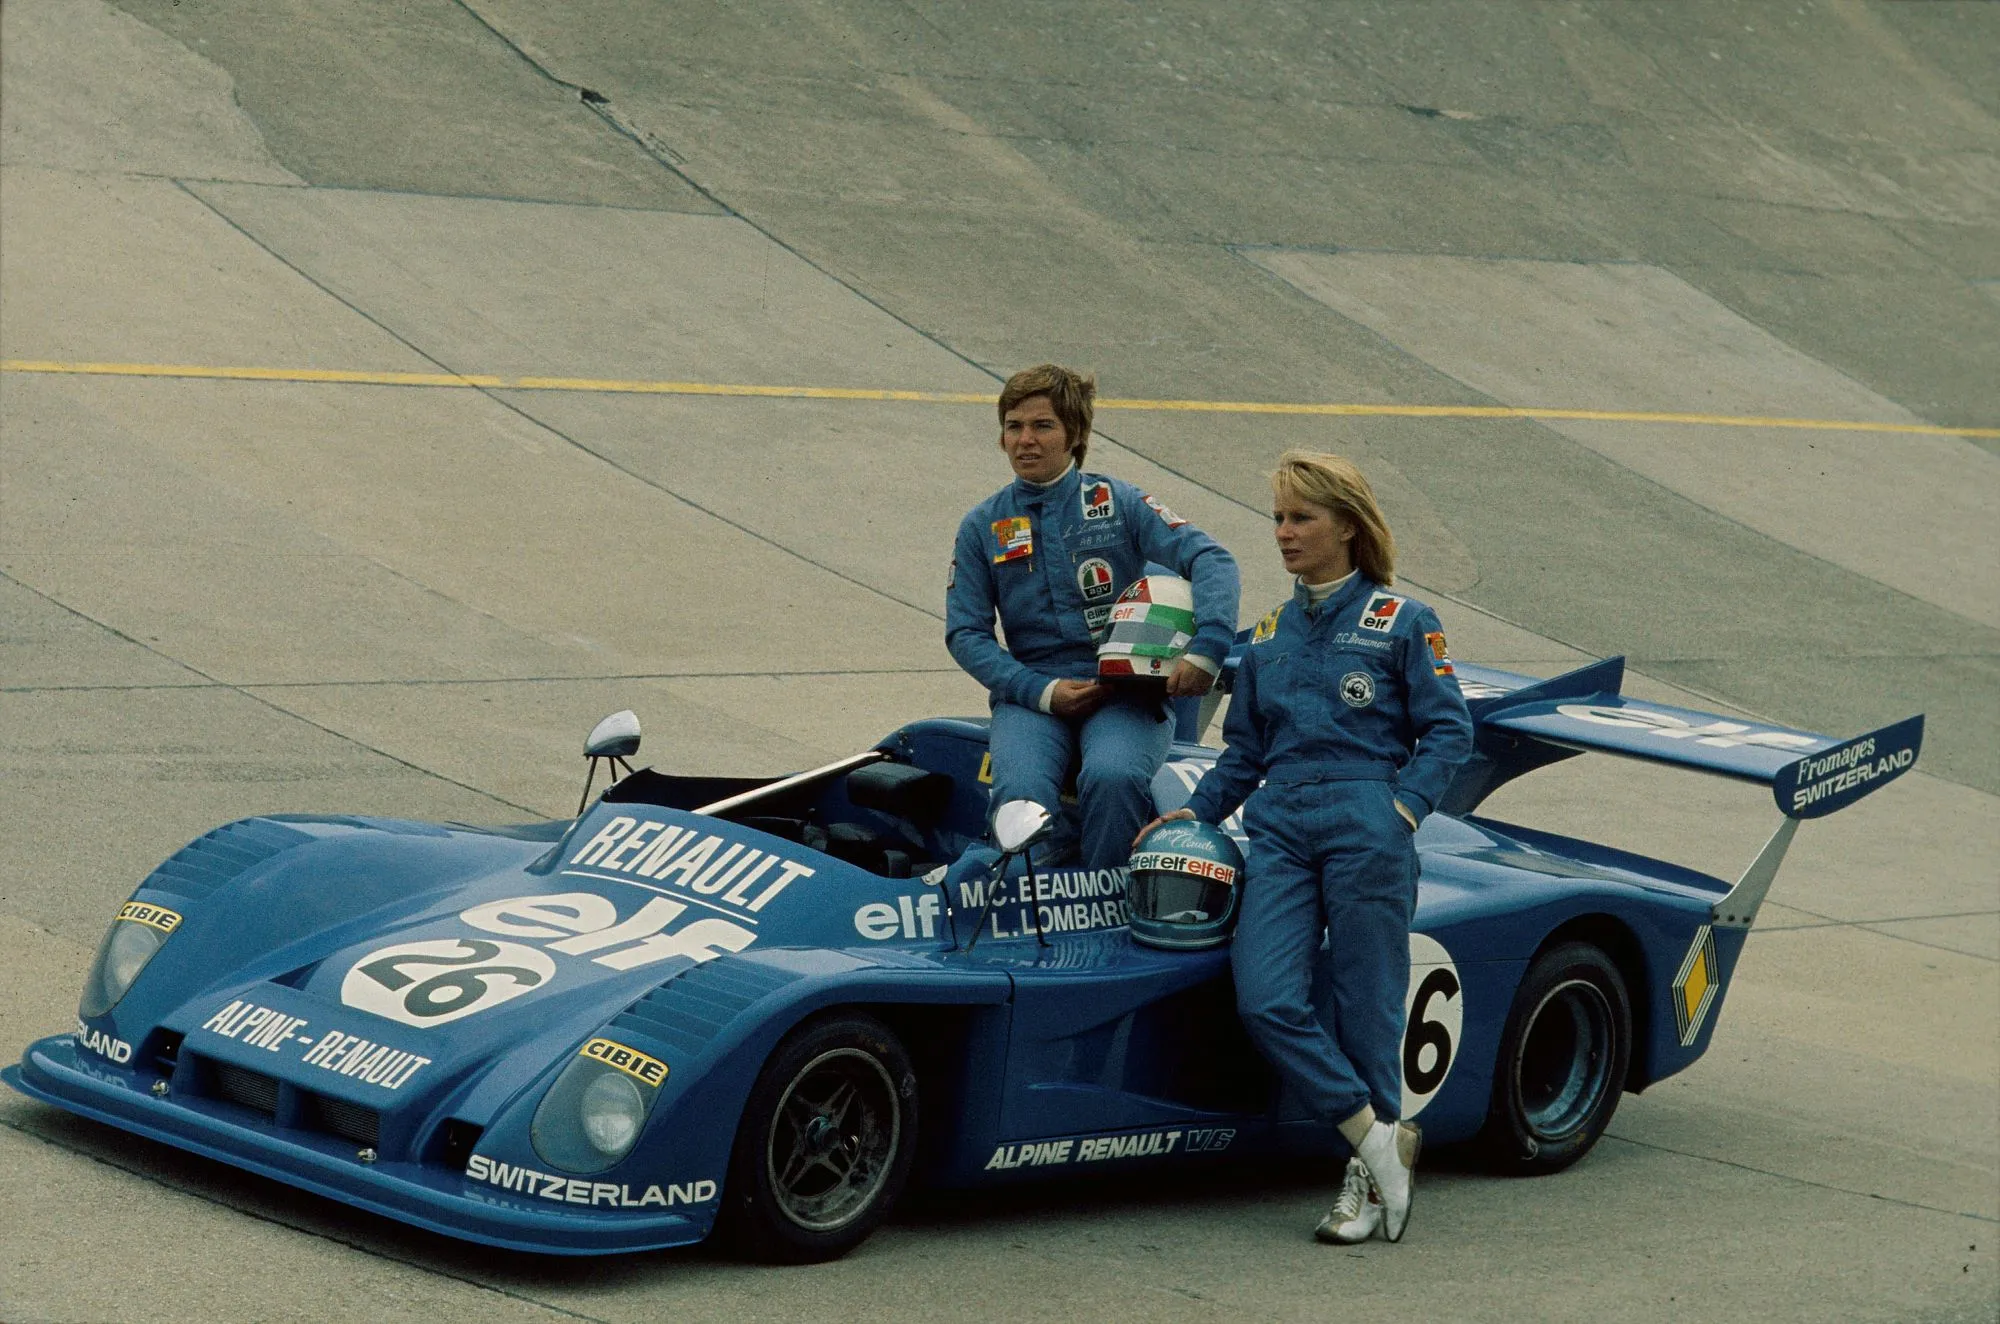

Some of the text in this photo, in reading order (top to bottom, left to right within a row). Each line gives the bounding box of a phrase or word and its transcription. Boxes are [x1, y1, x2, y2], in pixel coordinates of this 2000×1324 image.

[1087, 505, 1110, 518] elf
[1089, 585, 1109, 596] agv
[1115, 607, 1135, 619] elf
[1364, 617, 1388, 630] elf
[1793, 748, 1913, 811] SWITZERLAND
[1796, 737, 1876, 785] Fromages
[570, 816, 815, 913] RENAULT
[1018, 867, 1131, 904] BEAUMON
[1140, 855, 1160, 869] elf
[1160, 856, 1188, 871] elf
[1187, 860, 1214, 877] elf
[1213, 867, 1234, 884] elf
[120, 905, 178, 929] CIBIE
[459, 892, 758, 971] elf
[854, 893, 940, 940] elf
[357, 938, 533, 1018] 26
[1403, 967, 1460, 1096] 6
[587, 1042, 665, 1083] CIBIE
[984, 1128, 1237, 1171] ALPINE RENAULT V6
[466, 1154, 717, 1207] SWITZERLAND
